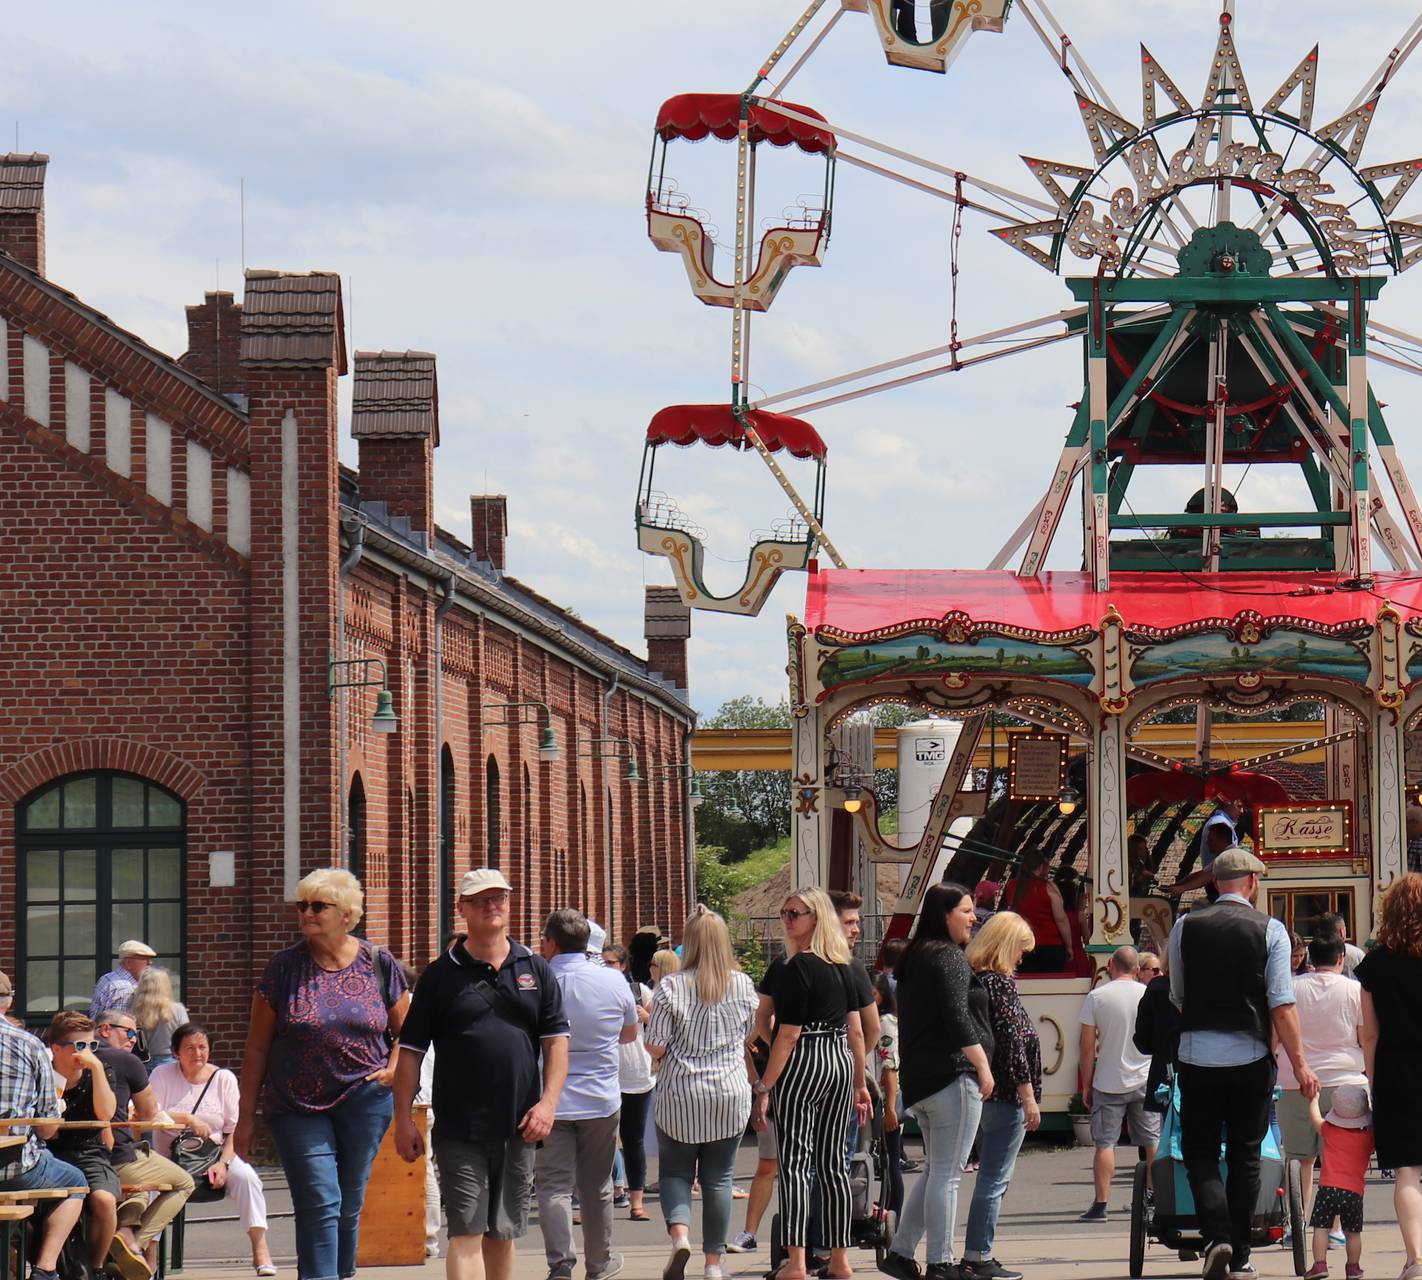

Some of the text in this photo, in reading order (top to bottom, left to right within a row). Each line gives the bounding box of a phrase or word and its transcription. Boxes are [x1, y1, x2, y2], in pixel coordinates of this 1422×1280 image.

[1066, 117, 1369, 275] Feldmann
[917, 751, 944, 761] TMG
[1272, 815, 1334, 837] Kasse
